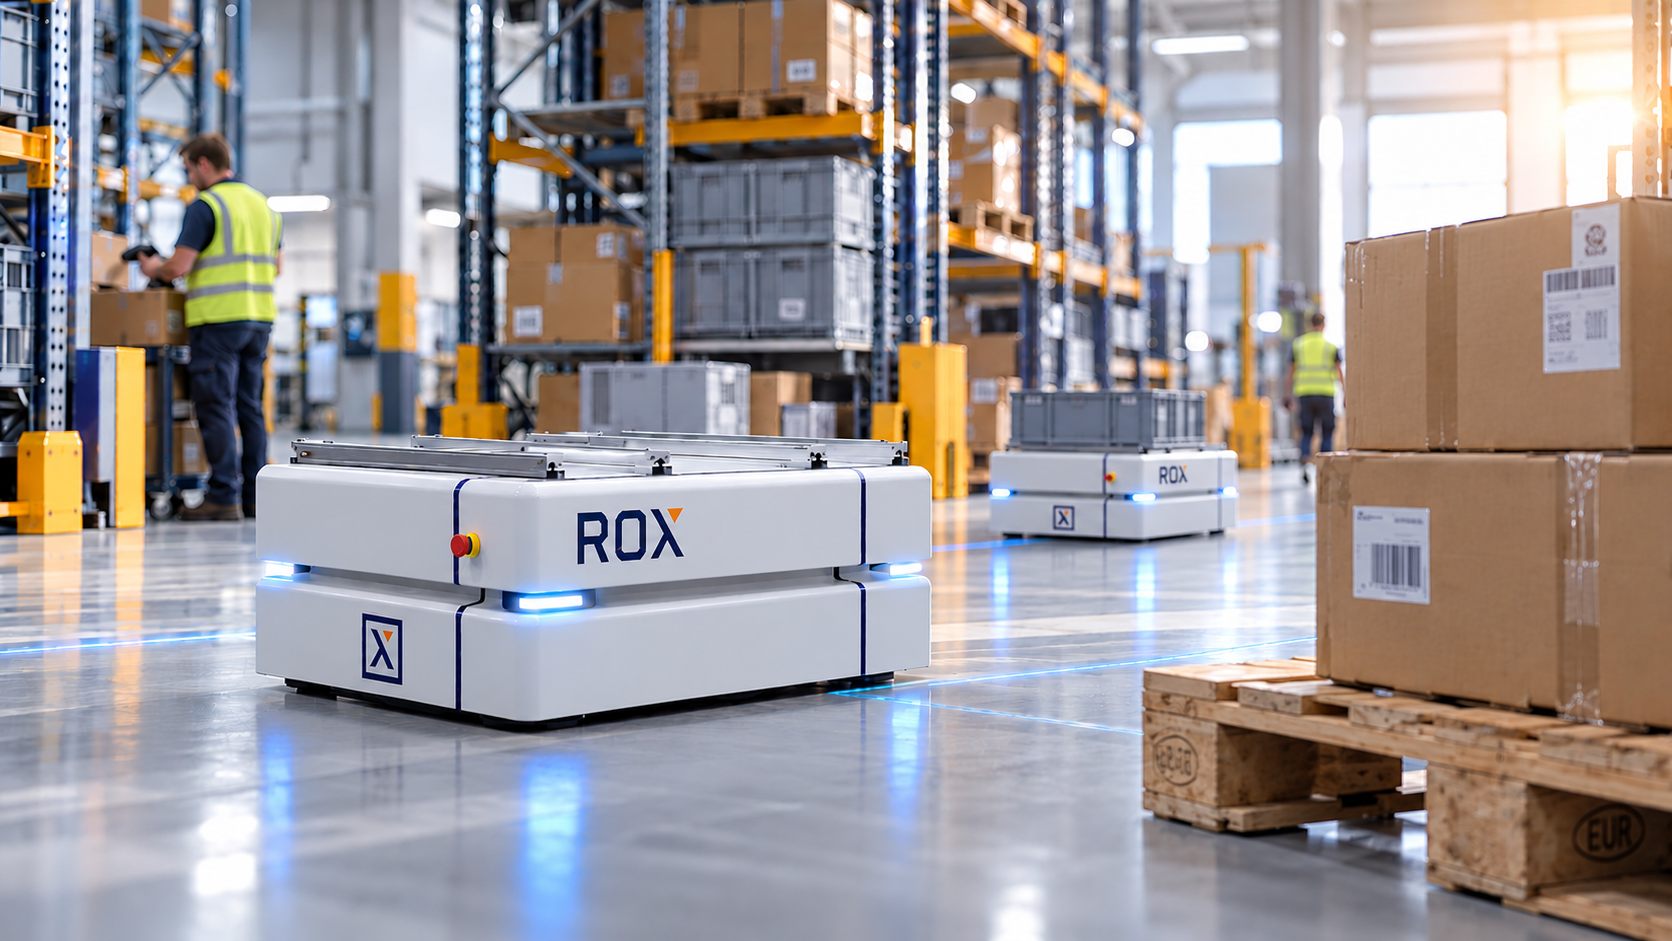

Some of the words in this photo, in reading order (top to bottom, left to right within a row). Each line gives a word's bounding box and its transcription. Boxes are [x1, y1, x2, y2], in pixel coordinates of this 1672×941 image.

[1158, 465, 1188, 484] ROX
[577, 507, 684, 565] ROX
[1587, 814, 1633, 852] EUR
